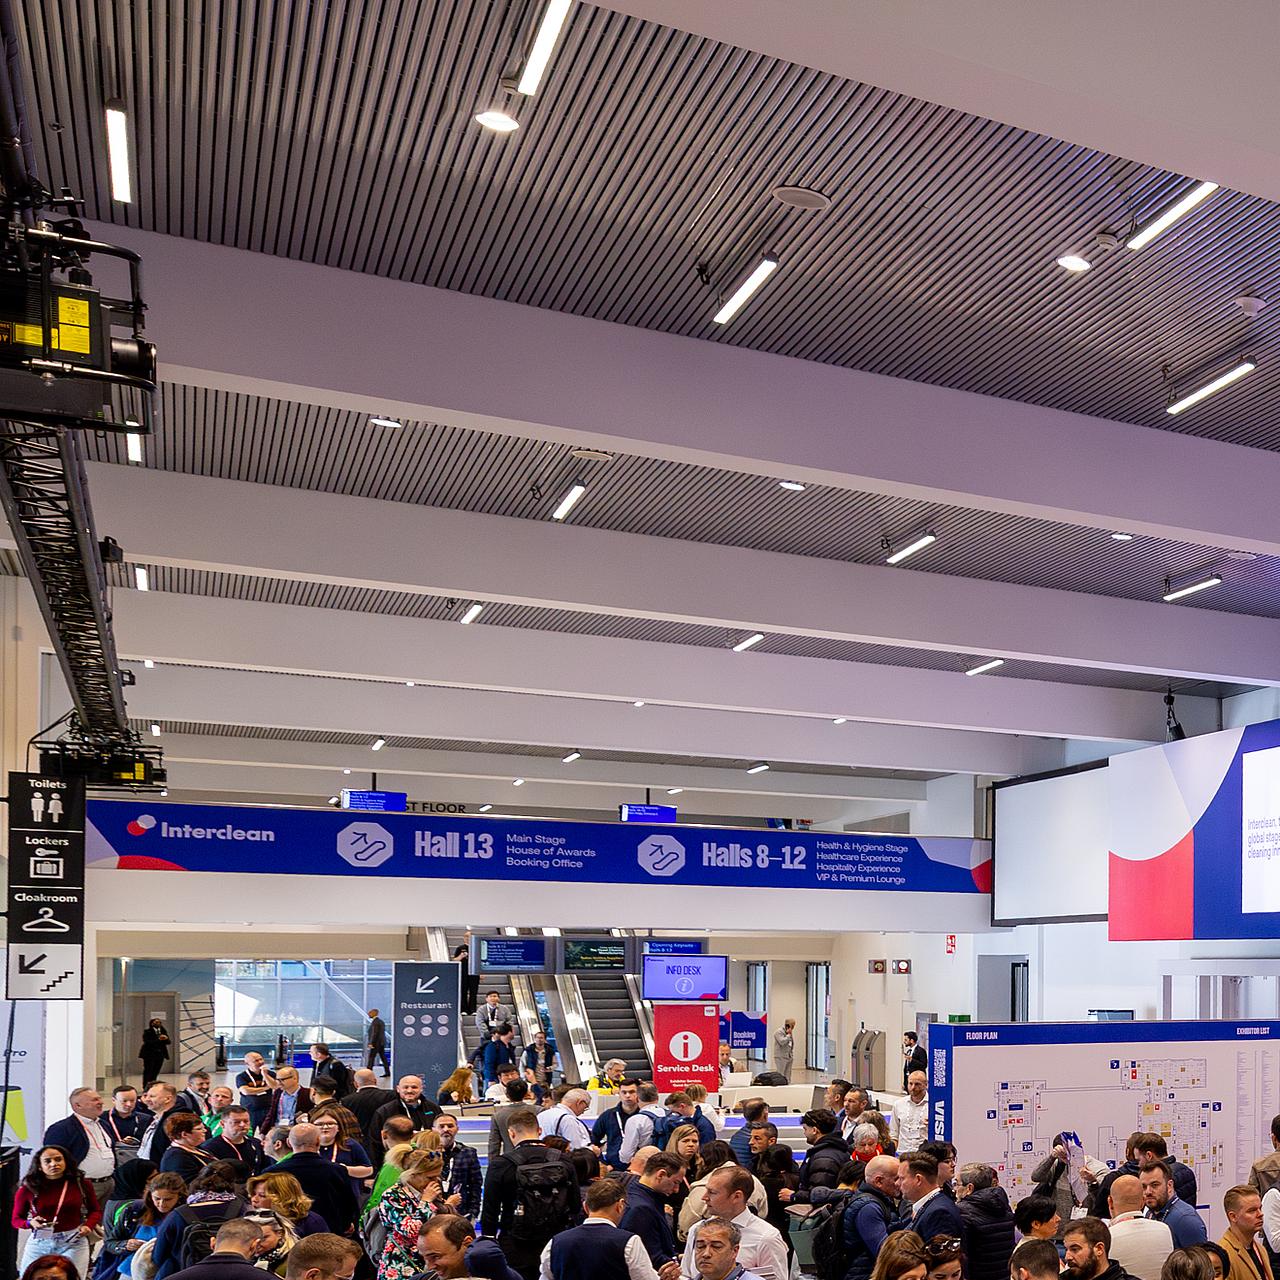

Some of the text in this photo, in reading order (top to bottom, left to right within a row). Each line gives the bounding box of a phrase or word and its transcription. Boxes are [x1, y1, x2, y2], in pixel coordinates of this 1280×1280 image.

[28, 778, 67, 789] Toilets
[422, 802, 466, 813] FLOOR
[1248, 818, 1277, 831] Interclean,
[162, 821, 275, 841] Interclean
[25, 835, 69, 846] Lockers
[415, 830, 494, 859] Hall 13
[506, 833, 566, 845] Main Stage
[1248, 833, 1265, 847] global
[506, 845, 597, 857] House of Awards
[816, 841, 909, 853] Health & Hygiene Stage
[702, 842, 753, 869] Halls
[816, 852, 904, 863] Healthcare Experience
[1248, 847, 1271, 860] cleaning
[506, 857, 583, 868] Booking Office
[816, 862, 901, 873] Hospitality Experience
[816, 873, 906, 885] VIP & Premium Lounge
[14, 892, 78, 904] Cloakroom
[666, 965, 702, 976] INFO DESK
[733, 1031, 756, 1040] Booking
[966, 1031, 998, 1040] FLOOR PLAN
[1236, 1027, 1270, 1035] EXHIBITOR LIST
[733, 1039, 752, 1047] Office
[657, 1064, 714, 1073] Service Desk
[935, 1100, 945, 1141] VISI
